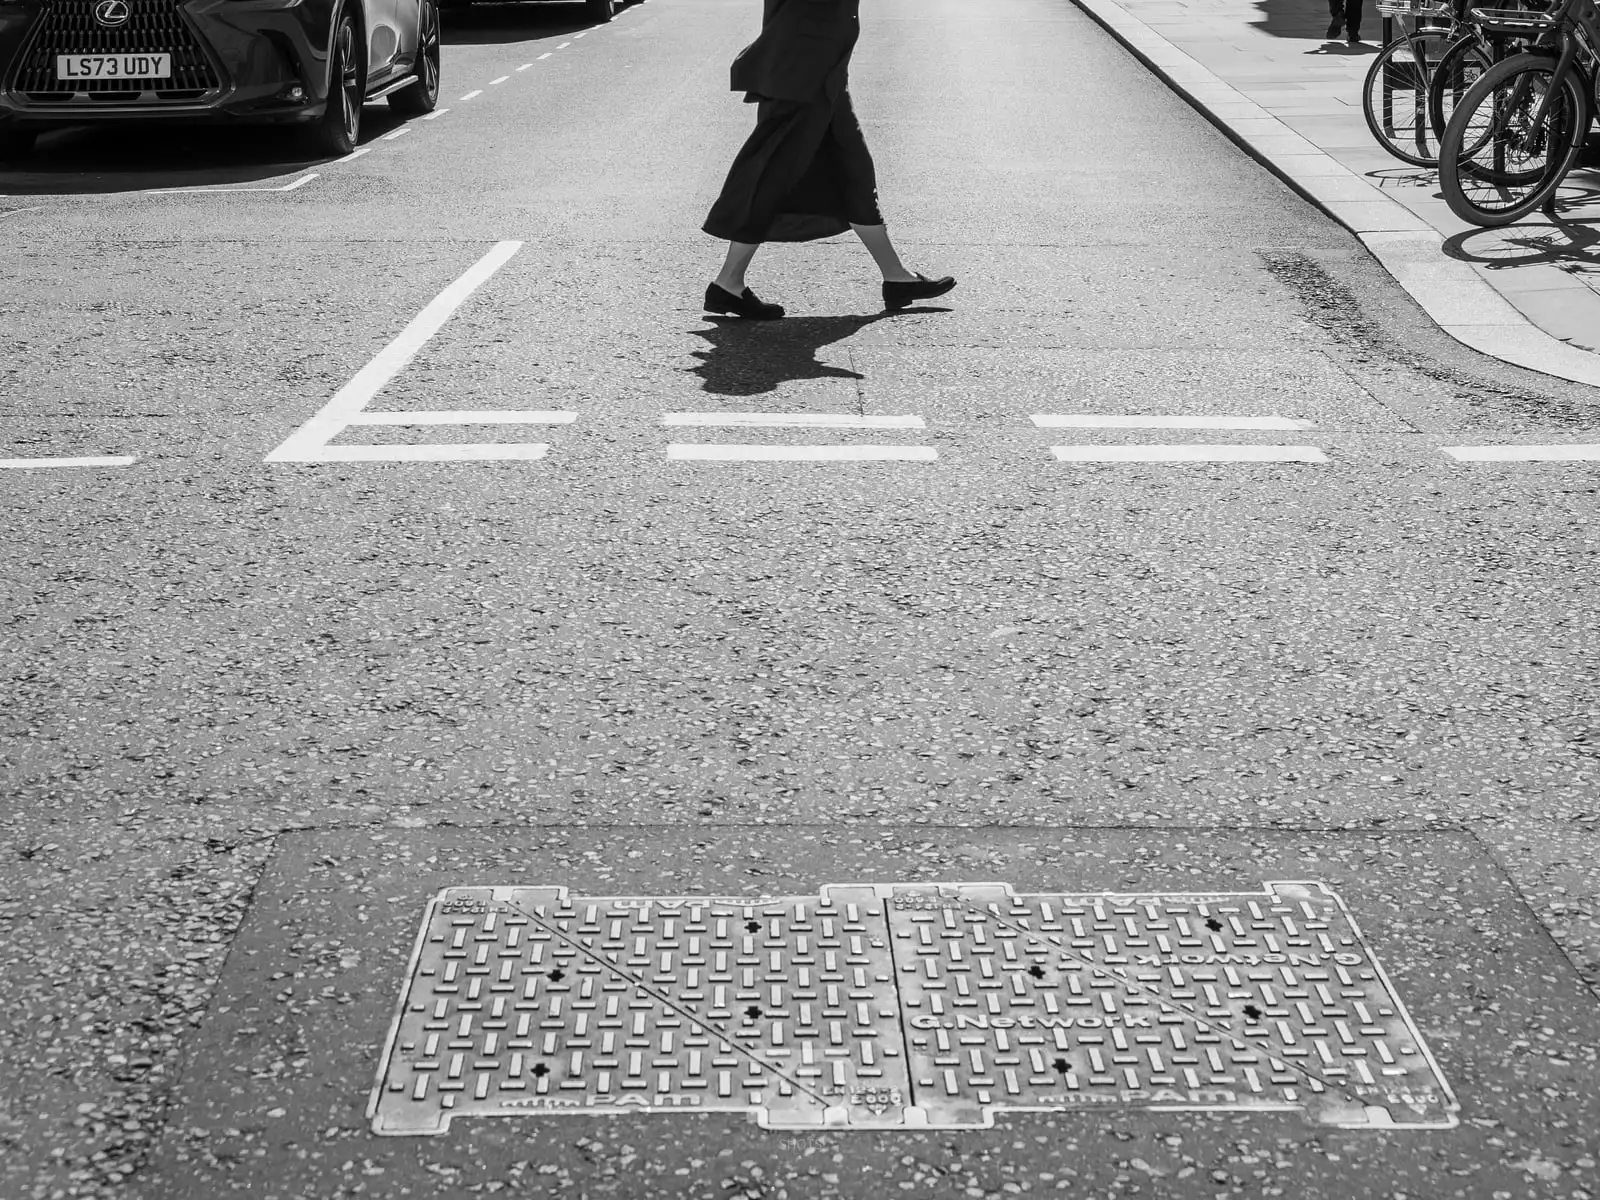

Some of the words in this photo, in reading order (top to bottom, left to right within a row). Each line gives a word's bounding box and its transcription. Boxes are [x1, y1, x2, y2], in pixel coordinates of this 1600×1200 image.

[66, 57, 118, 77] LS73
[124, 56, 163, 76] UDY
[909, 1013, 1152, 1030] G.Network
